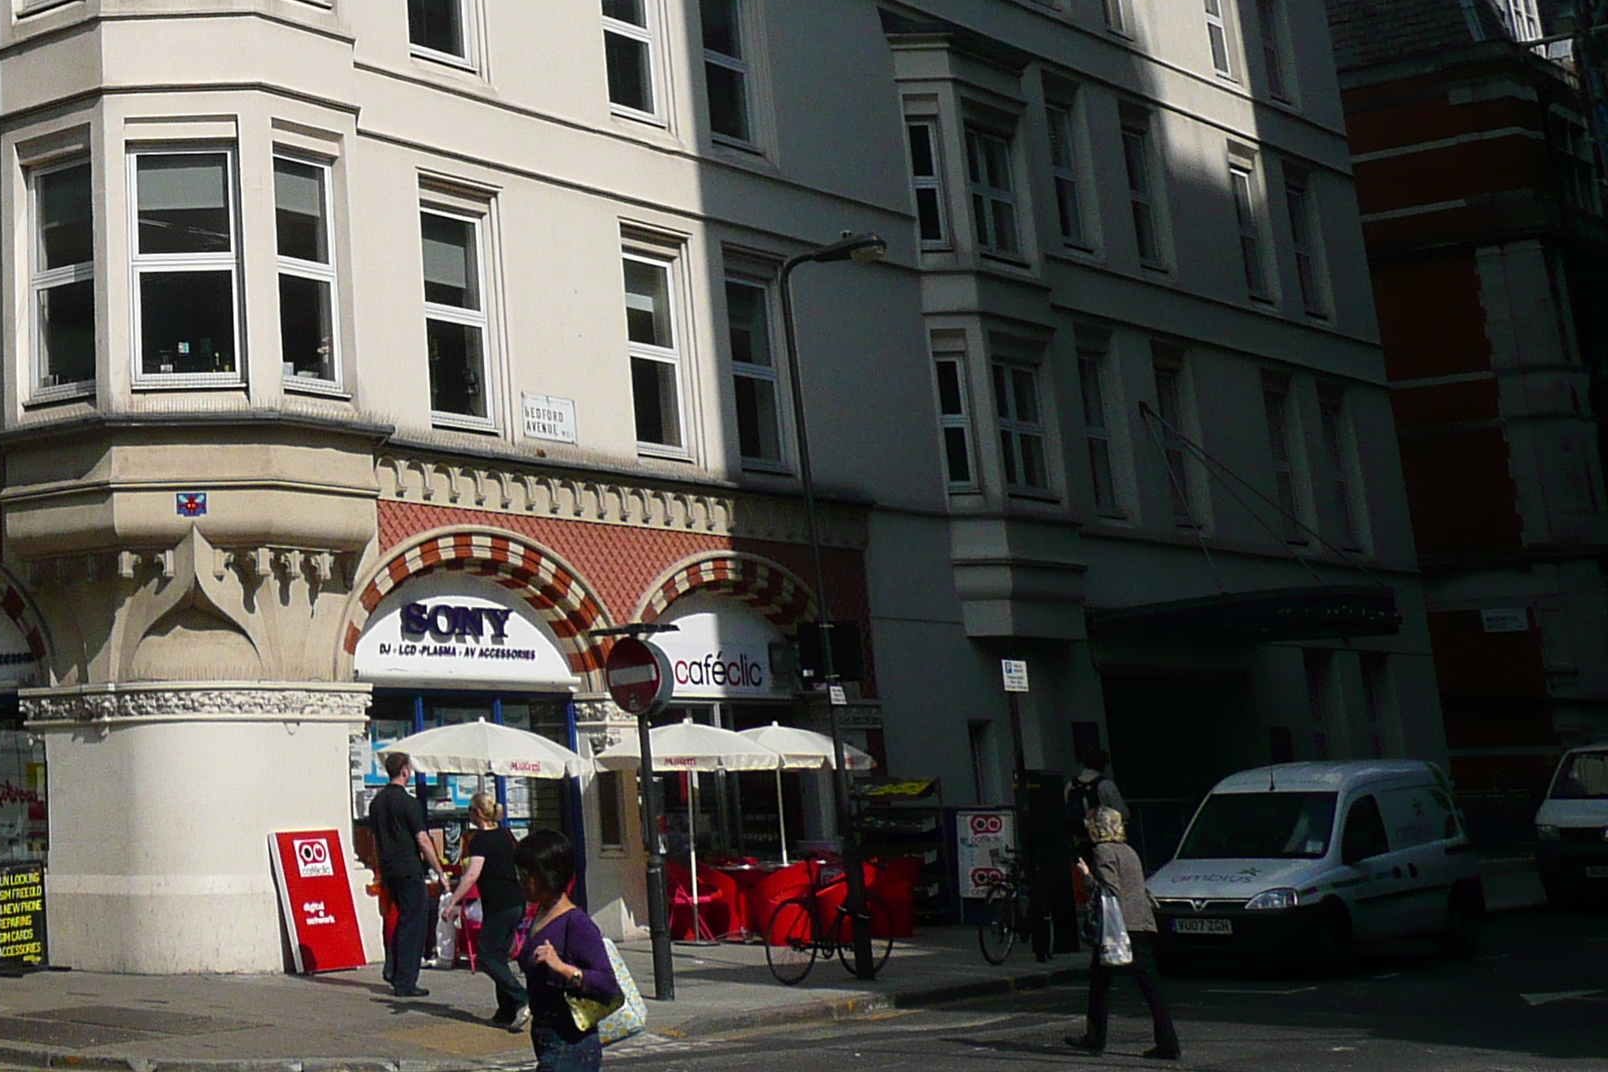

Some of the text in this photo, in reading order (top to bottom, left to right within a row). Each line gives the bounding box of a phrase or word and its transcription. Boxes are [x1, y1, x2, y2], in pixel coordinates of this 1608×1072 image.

[525, 406, 564, 423] BEDFORD
[526, 420, 558, 436] AVENUE
[403, 602, 514, 638] SONY
[379, 643, 391, 656] DJ
[398, 645, 417, 656] LCD
[464, 647, 477, 658] AV
[478, 647, 536, 661] ACCESSORIES
[674, 651, 763, 687] caféclic
[11, 928, 34, 942] CARDS
